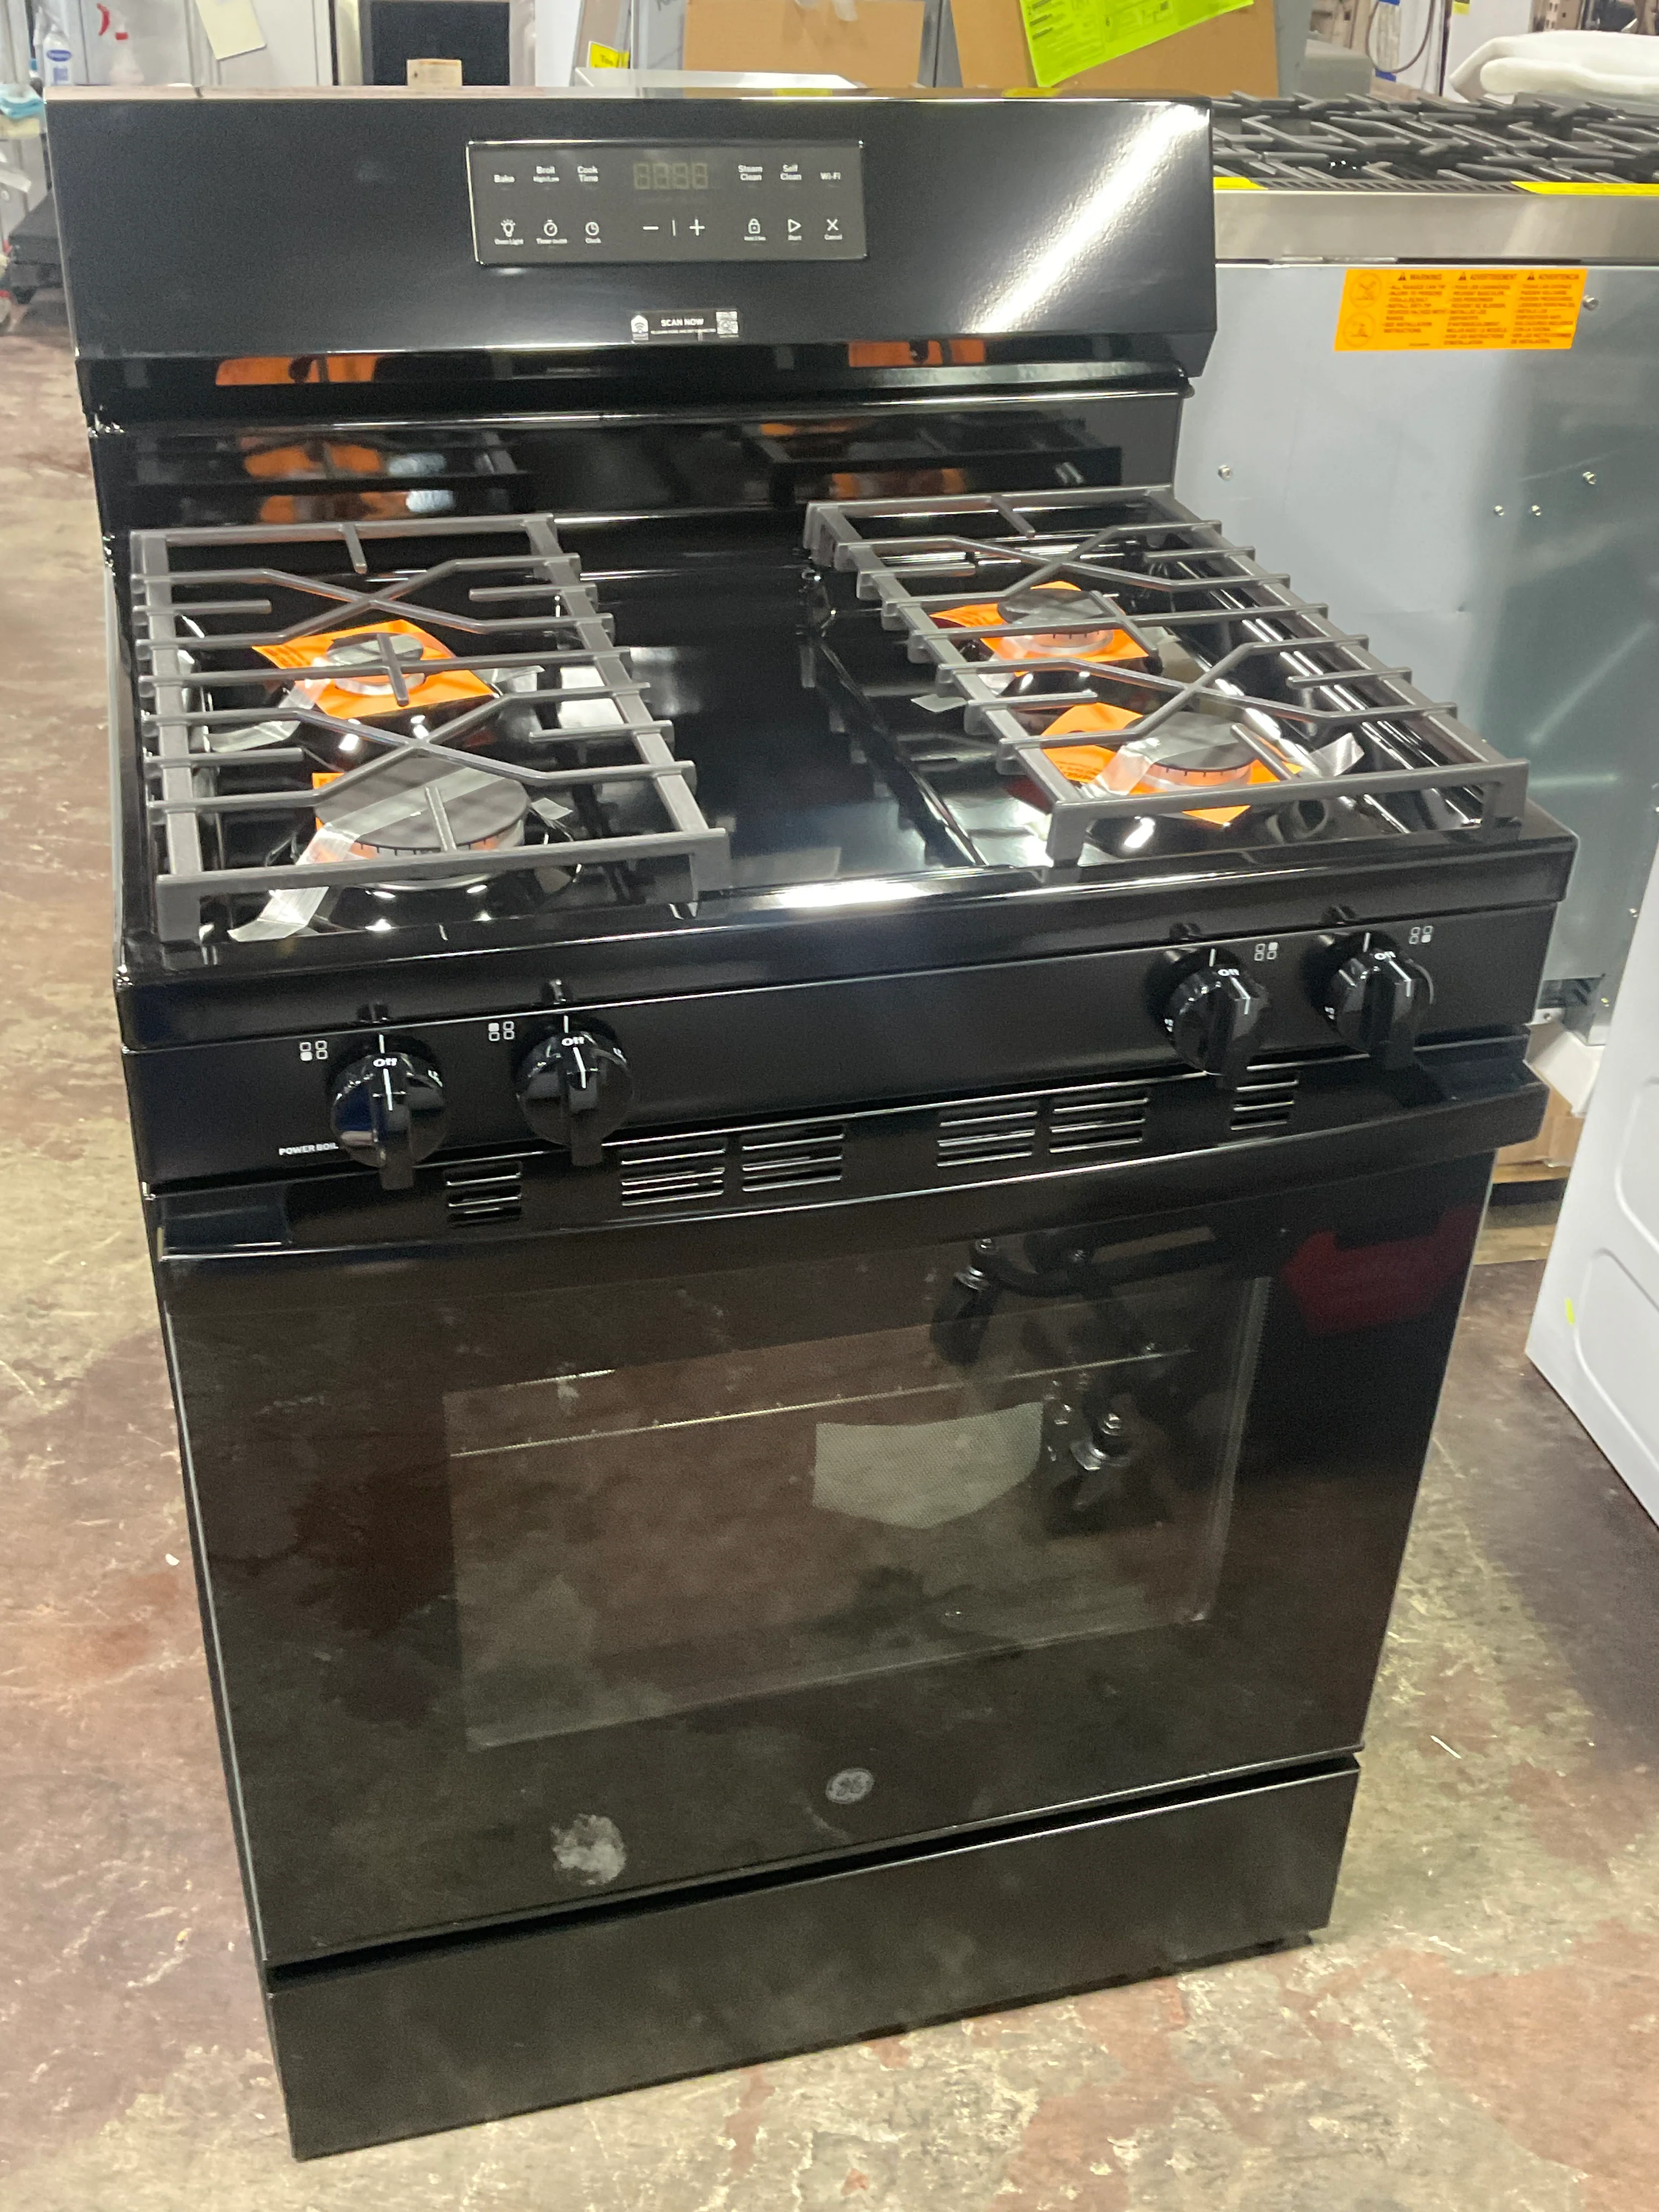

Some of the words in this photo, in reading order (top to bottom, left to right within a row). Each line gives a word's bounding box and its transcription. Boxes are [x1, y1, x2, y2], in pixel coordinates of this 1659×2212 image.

[661, 318, 683, 326] SCAN
[684, 318, 704, 326] NOW
[279, 1144, 315, 1155] POWER
[316, 1142, 339, 1151] BOIL
